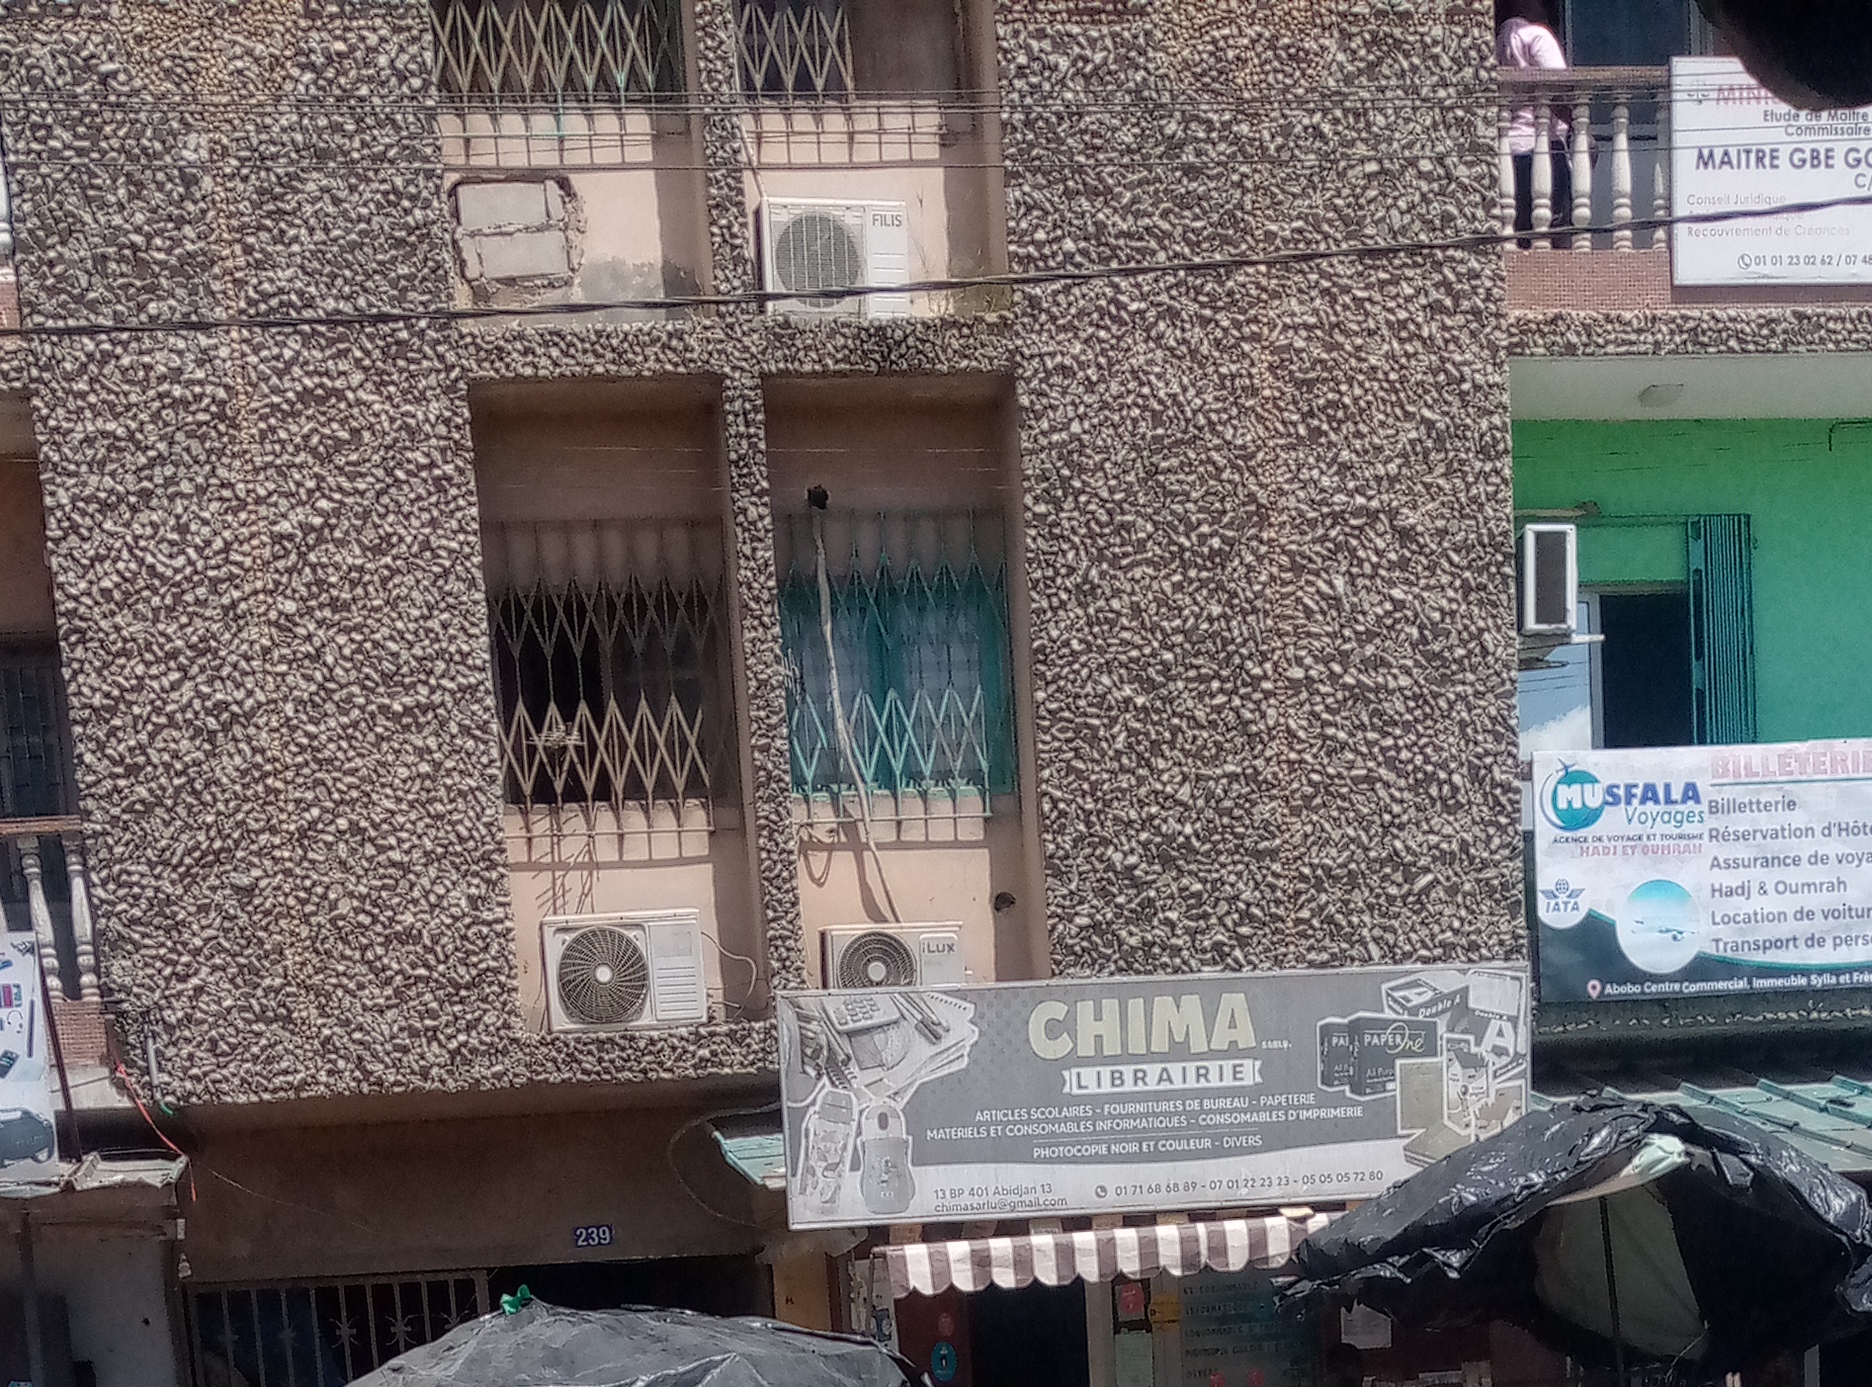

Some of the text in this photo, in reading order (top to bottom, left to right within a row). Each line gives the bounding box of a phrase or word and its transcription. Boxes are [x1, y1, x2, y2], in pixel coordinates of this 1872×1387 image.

[1763, 109, 1800, 123] Etude
[1805, 110, 1822, 122] de
[1784, 124, 1871, 137] Commissaire
[1695, 147, 1780, 170] MAITRE
[1789, 147, 1835, 170] GBE
[1687, 193, 1786, 208] Conseil Juridique
[872, 213, 902, 228] FILIS
[1687, 225, 1773, 237] Recouvrement
[1775, 225, 1790, 236] de
[1754, 255, 1766, 266] 01
[1771, 255, 1783, 266] 01
[1787, 255, 1801, 266] 23
[1803, 255, 1817, 266] 02
[1820, 254, 1833, 266] 62
[1845, 254, 1858, 265] 07
[1556, 782, 1702, 810] MUSFALA
[1708, 795, 1797, 815] Billetterie
[1624, 807, 1705, 829] Voyages
[1708, 823, 1816, 843] Réservation
[1709, 854, 1801, 871] Assurance
[1807, 849, 1830, 866] de
[1710, 876, 1848, 901] Hadj & Oumrah
[1546, 901, 1580, 914] IATA
[1711, 907, 1787, 926] Location
[1793, 905, 1816, 922] de
[1711, 934, 1800, 955] Transport
[1804, 933, 1827, 949] de
[1604, 983, 1642, 995] Abobo
[1644, 981, 1681, 994] Centre
[1682, 976, 1750, 993] Commercial,
[1753, 973, 1808, 989] Immeuble
[1810, 972, 1837, 987] Sylla
[1839, 973, 1850, 984] et
[1419, 998, 1450, 1018] Double
[1453, 994, 1461, 1005] A
[1028, 992, 1257, 1061] CHIMA
[1364, 1033, 1402, 1047] PAPER
[1076, 1063, 1245, 1090] LIBRAIRIE
[975, 1108, 1028, 1122] ARTICLES
[1030, 1105, 1093, 1119] SCOLAIRES
[1104, 1101, 1183, 1115] FOURNITURES
[1185, 1099, 1201, 1110] DE
[1203, 1097, 1249, 1110] BUREAU
[1260, 1093, 1316, 1107] PAPETERIE
[926, 1127, 987, 1141] MATERIELS
[990, 1126, 1002, 1137] ET
[1005, 1122, 1093, 1137] CONSOMABLES
[1096, 1113, 1187, 1132] INFORMATIQUES
[1198, 1110, 1285, 1126] CONSOMABLES
[1033, 1145, 1108, 1159] PHOTOCOPIE
[1110, 1142, 1140, 1155] NOIR
[1142, 1141, 1155, 1152] ET
[1159, 1137, 1212, 1151] COULEUR
[1223, 1135, 1263, 1149] DIVERS
[933, 1183, 1052, 1200] 13 BP 401 Abidjan 13
[1115, 1185, 1128, 1196] 01
[1130, 1184, 1143, 1196] 71
[1147, 1183, 1162, 1194] 68
[1166, 1182, 1180, 1193] 68
[1183, 1181, 1197, 1192] 89
[1209, 1180, 1223, 1191] 07
[1227, 1179, 1240, 1190] 01
[1243, 1178, 1257, 1189] 22
[1260, 1177, 1273, 1188] 23
[1276, 1176, 1290, 1187] 23
[1302, 1174, 1316, 1185] 05
[1318, 1173, 1332, 1185] 05
[1336, 1172, 1350, 1184] 05
[1352, 1171, 1366, 1182] 72
[1369, 1170, 1384, 1181] 80
[934, 1196, 1067, 1213] chimasarlu@gmail.com
[575, 1225, 612, 1247] 239
